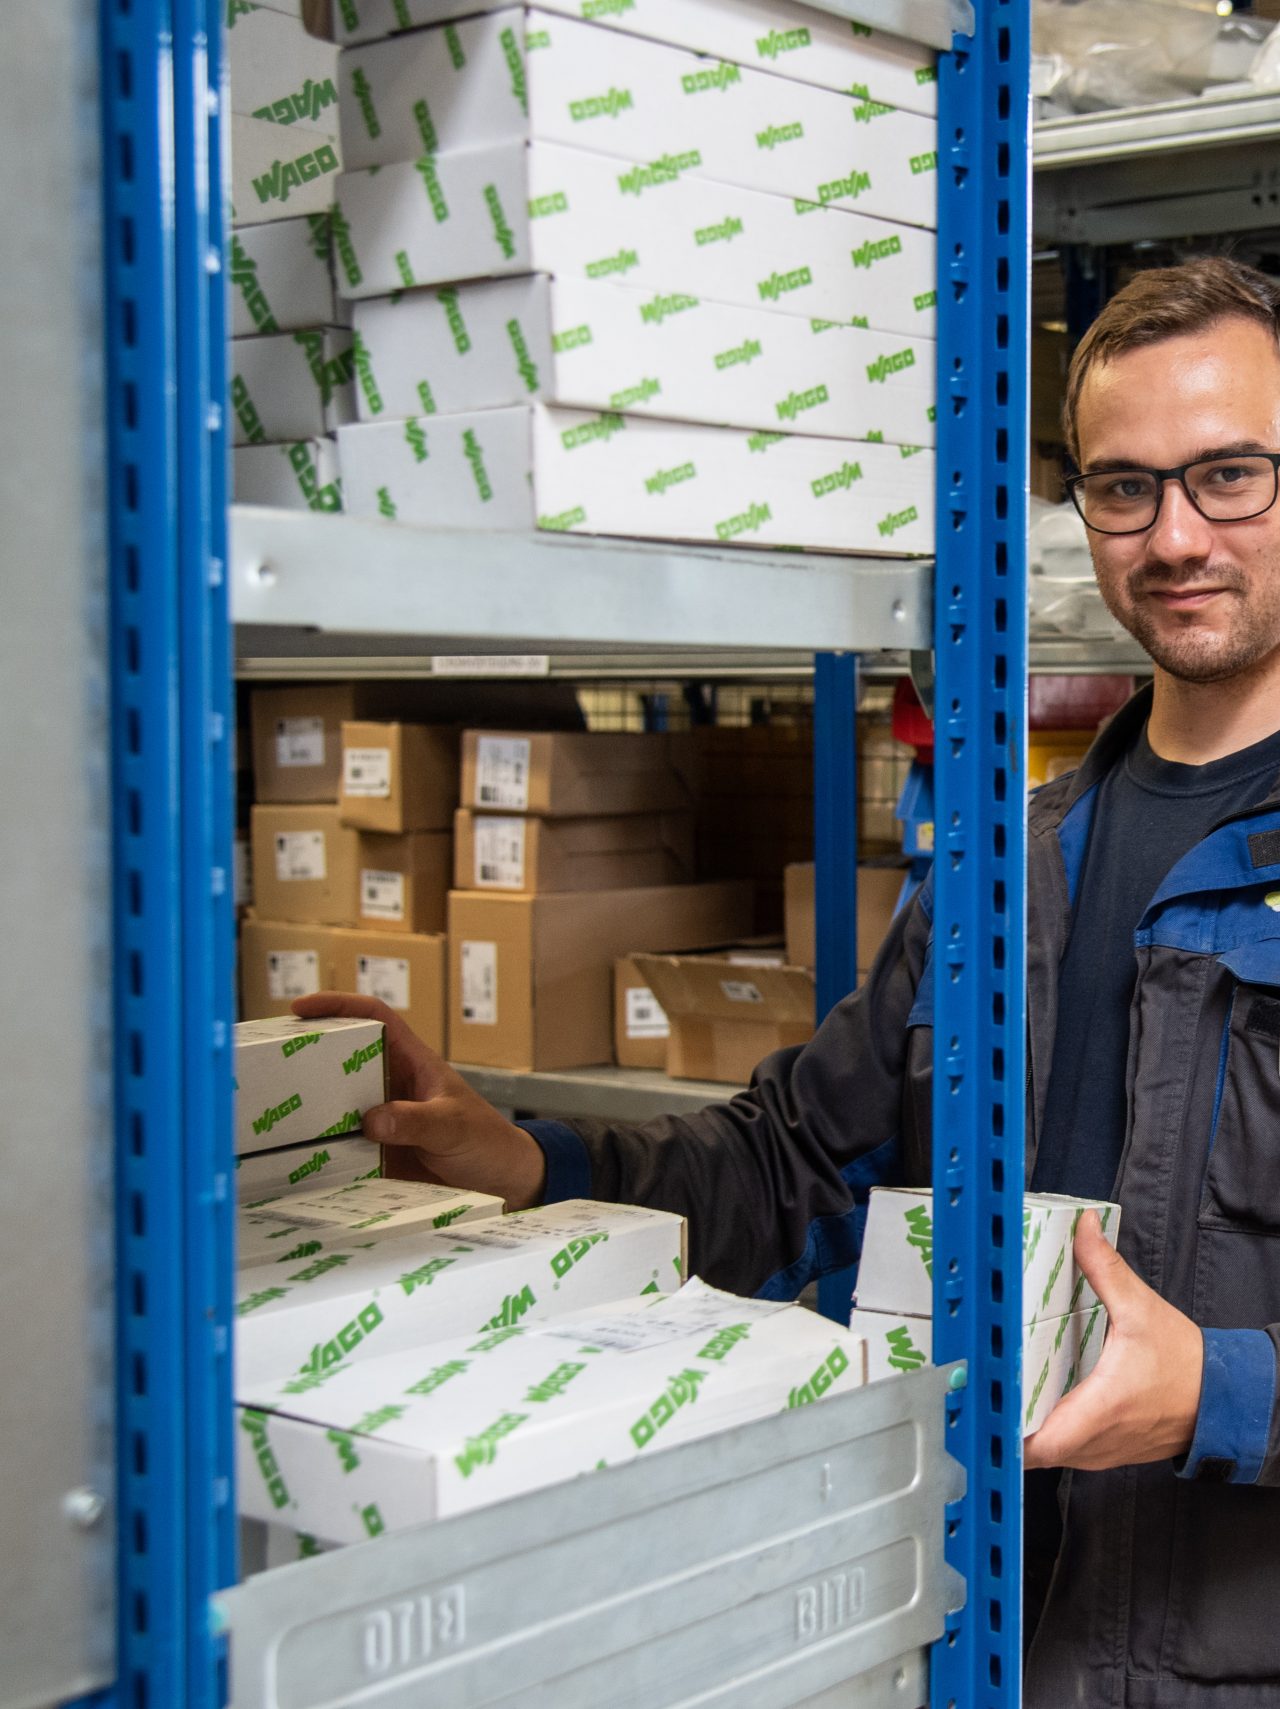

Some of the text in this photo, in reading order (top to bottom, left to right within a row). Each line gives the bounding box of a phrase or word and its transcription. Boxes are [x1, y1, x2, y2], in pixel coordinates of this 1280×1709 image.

[755, 27, 813, 59] WAGO
[681, 61, 743, 95] WAGO
[568, 87, 634, 122] WAGO
[755, 121, 806, 151] WAGO
[252, 145, 339, 203] WAGO
[817, 170, 873, 205] WAGO
[693, 217, 745, 248] WAGO
[585, 249, 640, 280] WAGO
[850, 234, 904, 270] WAGO
[757, 265, 814, 302] WAGO
[713, 340, 763, 371] WAGO
[865, 347, 918, 384] WAGO
[775, 384, 831, 422] WAGO
[644, 461, 697, 495] WAGO
[810, 462, 864, 499] WAGO
[714, 502, 773, 542] WAGO
[876, 505, 920, 538] WAGO
[252, 1093, 303, 1136] WAGO
[288, 1150, 331, 1185] WAGO
[697, 1322, 752, 1364] WAGO
